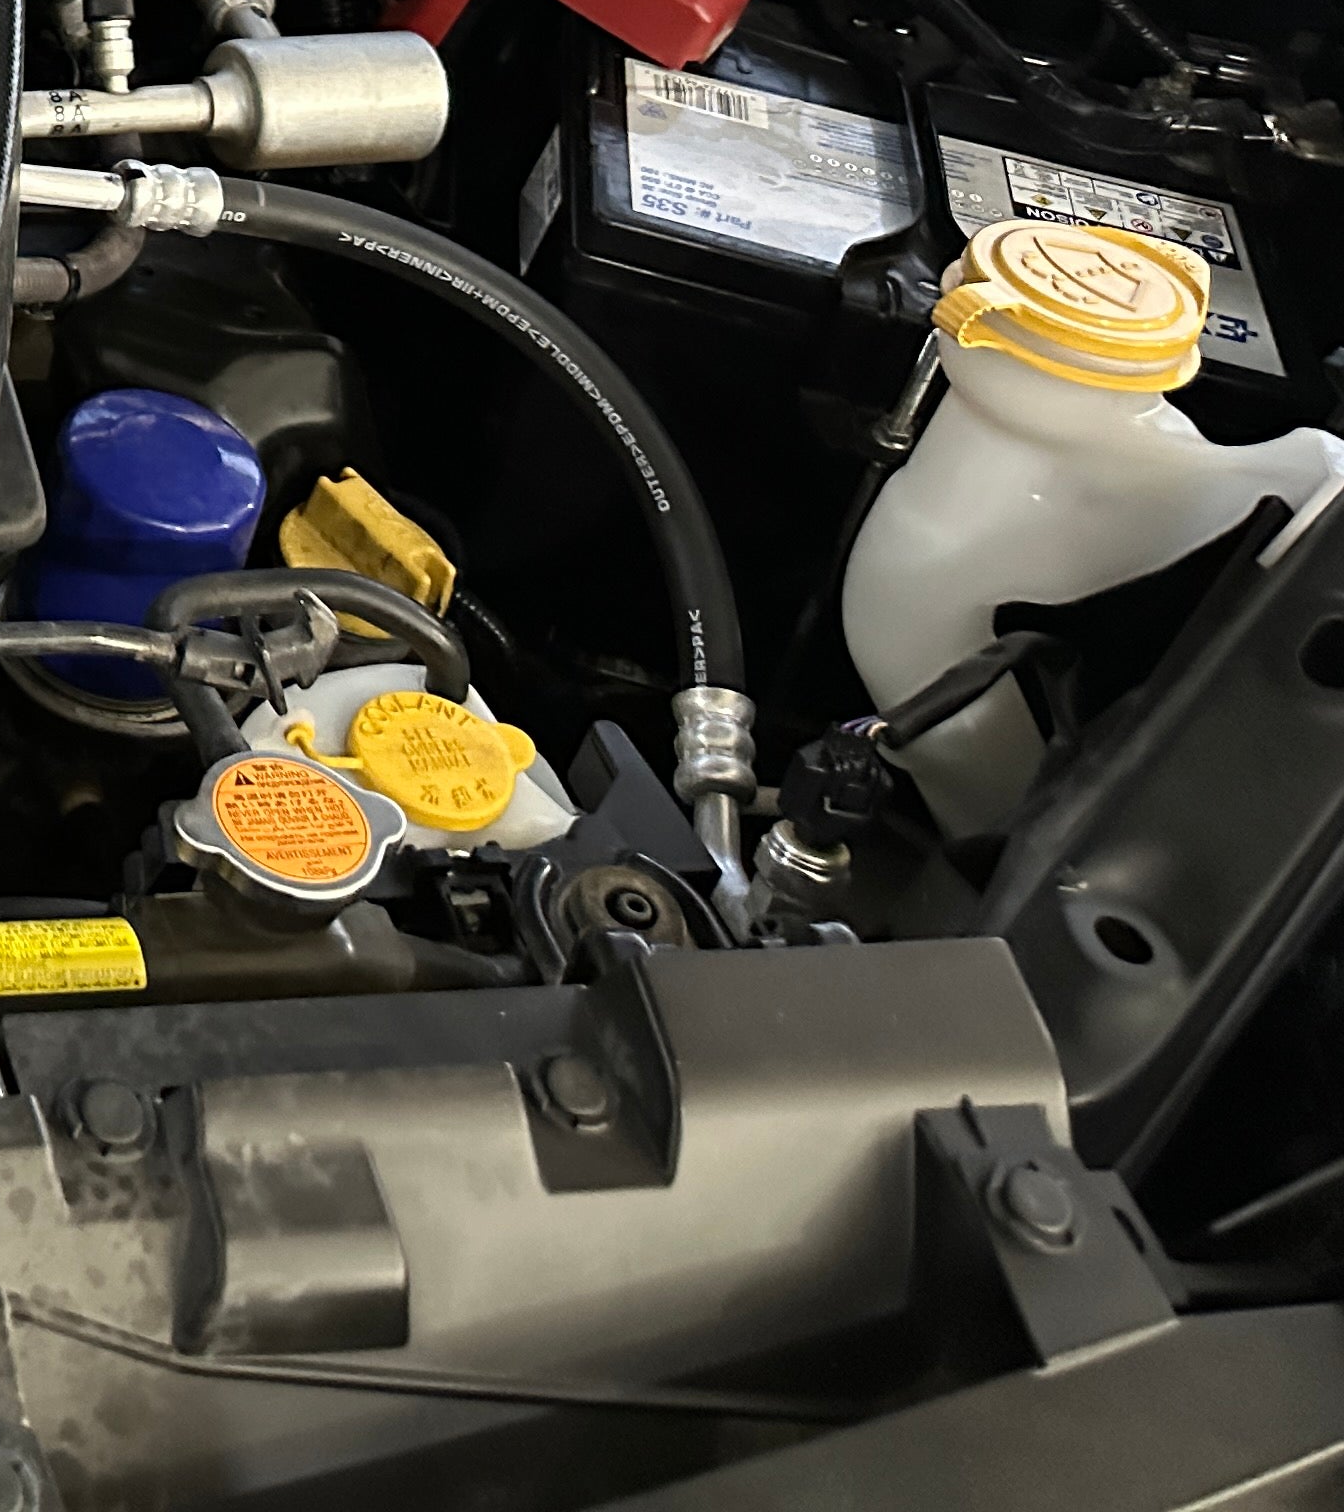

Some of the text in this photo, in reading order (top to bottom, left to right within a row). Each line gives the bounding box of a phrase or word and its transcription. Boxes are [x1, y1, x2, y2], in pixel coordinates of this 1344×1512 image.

[640, 194, 688, 216] S35
[715, 212, 753, 230] Part
[359, 694, 478, 735] COOLANT
